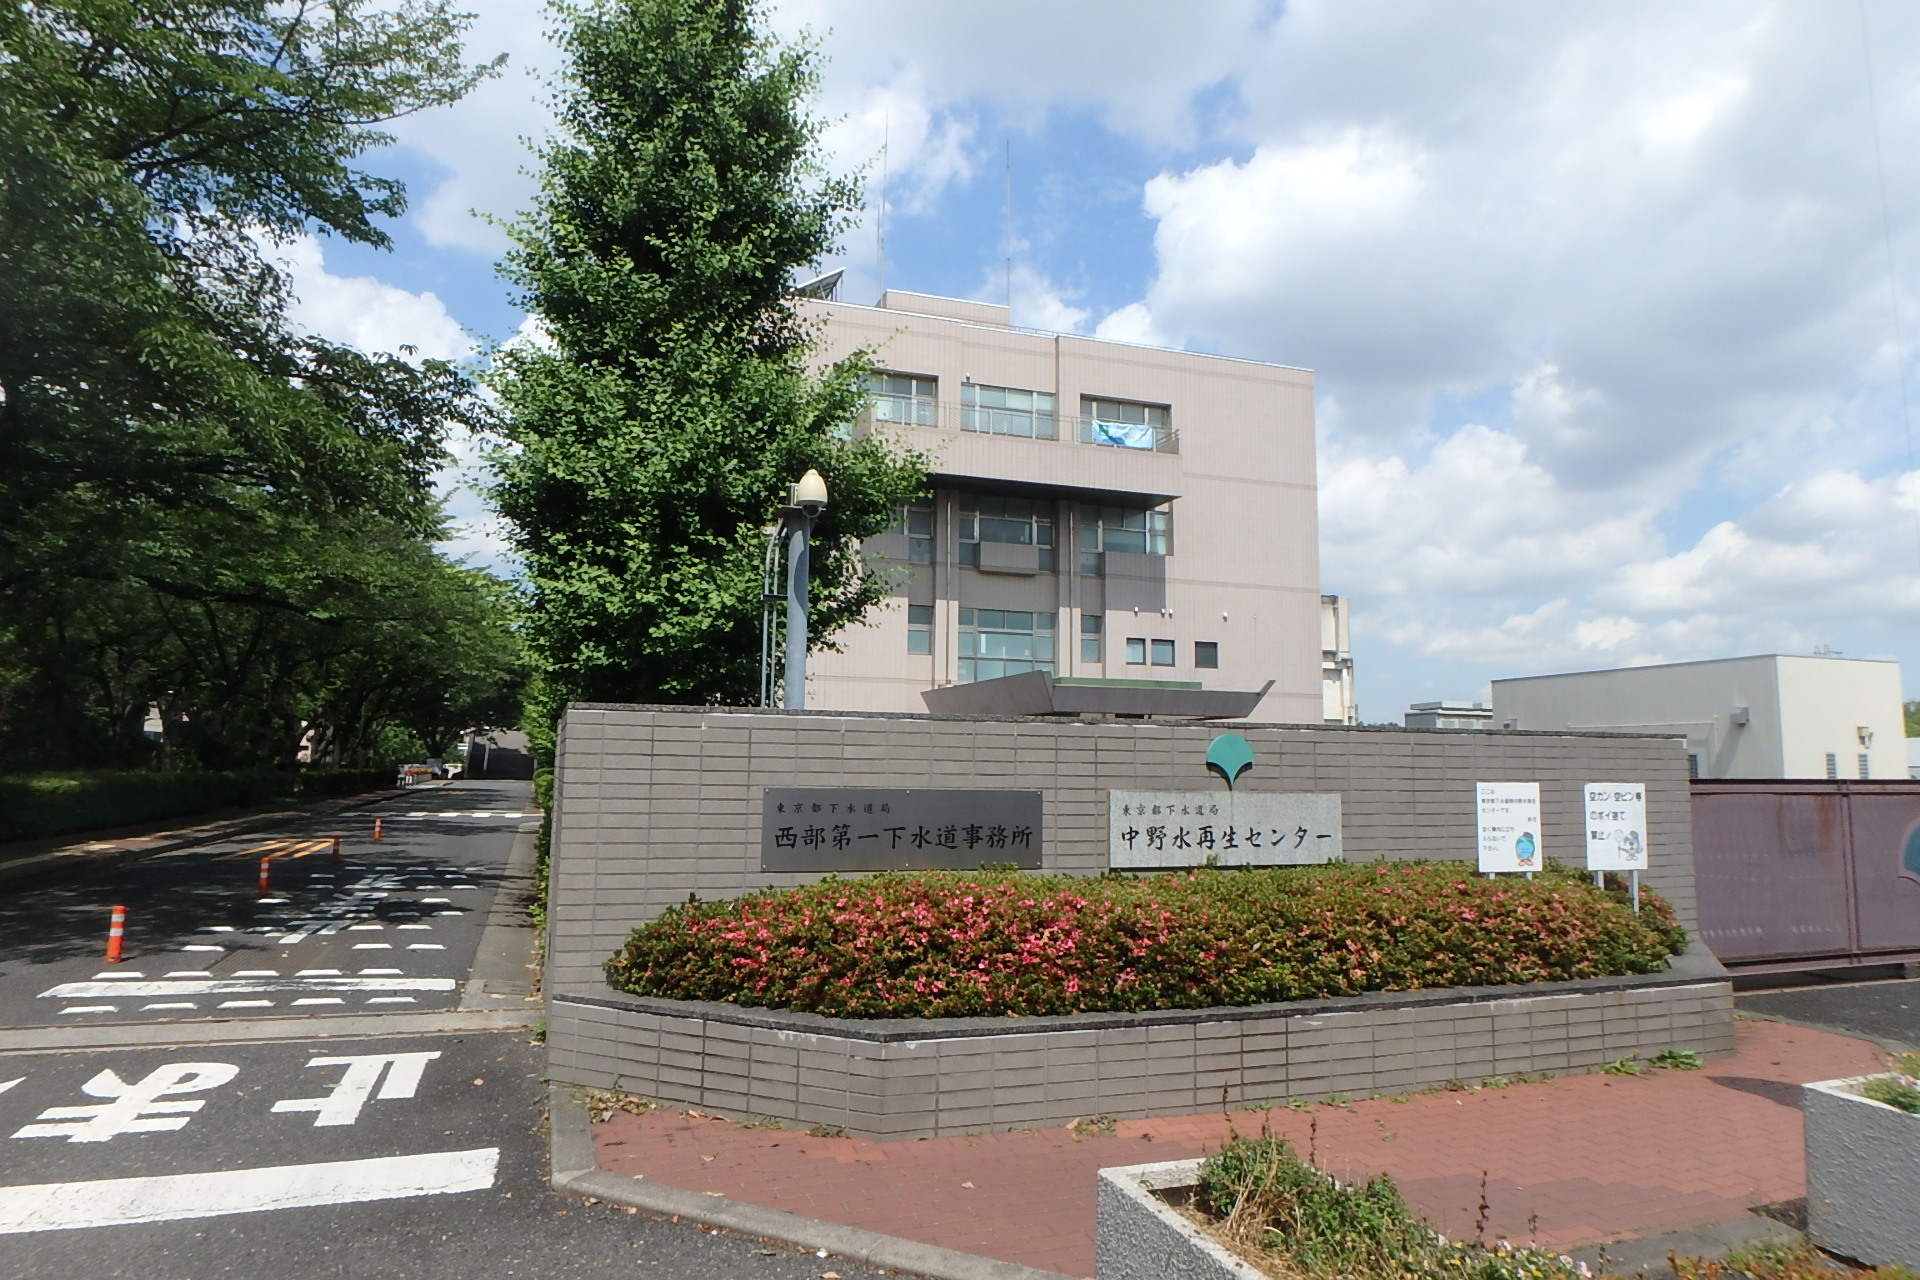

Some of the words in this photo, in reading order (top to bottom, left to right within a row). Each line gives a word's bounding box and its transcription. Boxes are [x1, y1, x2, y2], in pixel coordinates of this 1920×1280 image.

[776, 802, 891, 815] 東京都下水道局
[1121, 804, 1219, 816] 東京都下水道局
[774, 823, 1034, 851] 西部第一下水道事務所
[1121, 825, 1332, 851] 中野水再生センター
[0, 1051, 441, 1143] 止ま
